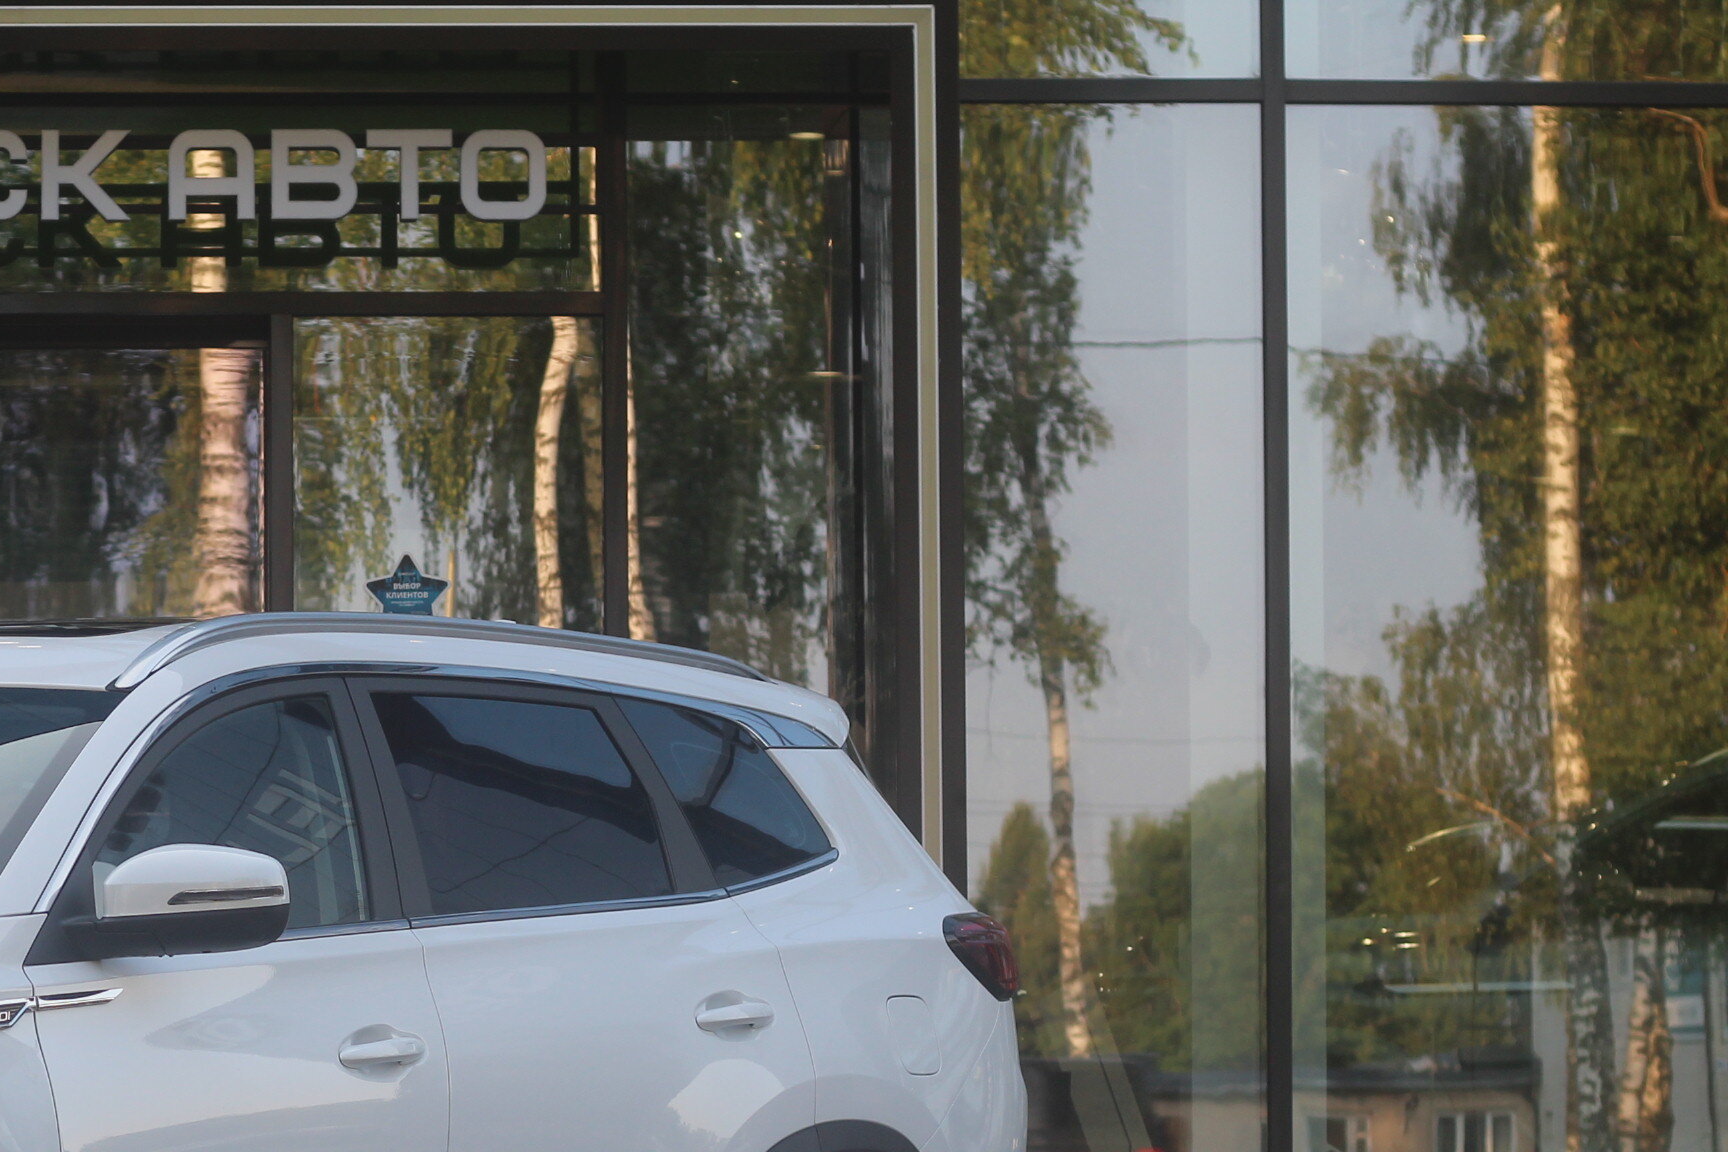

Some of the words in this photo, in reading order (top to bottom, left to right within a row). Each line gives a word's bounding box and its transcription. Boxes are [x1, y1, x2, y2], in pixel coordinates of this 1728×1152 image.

[168, 128, 548, 221] АВТО
[393, 582, 421, 590] ВЫБОР
[386, 591, 429, 599] КЛИЕНТОВ
